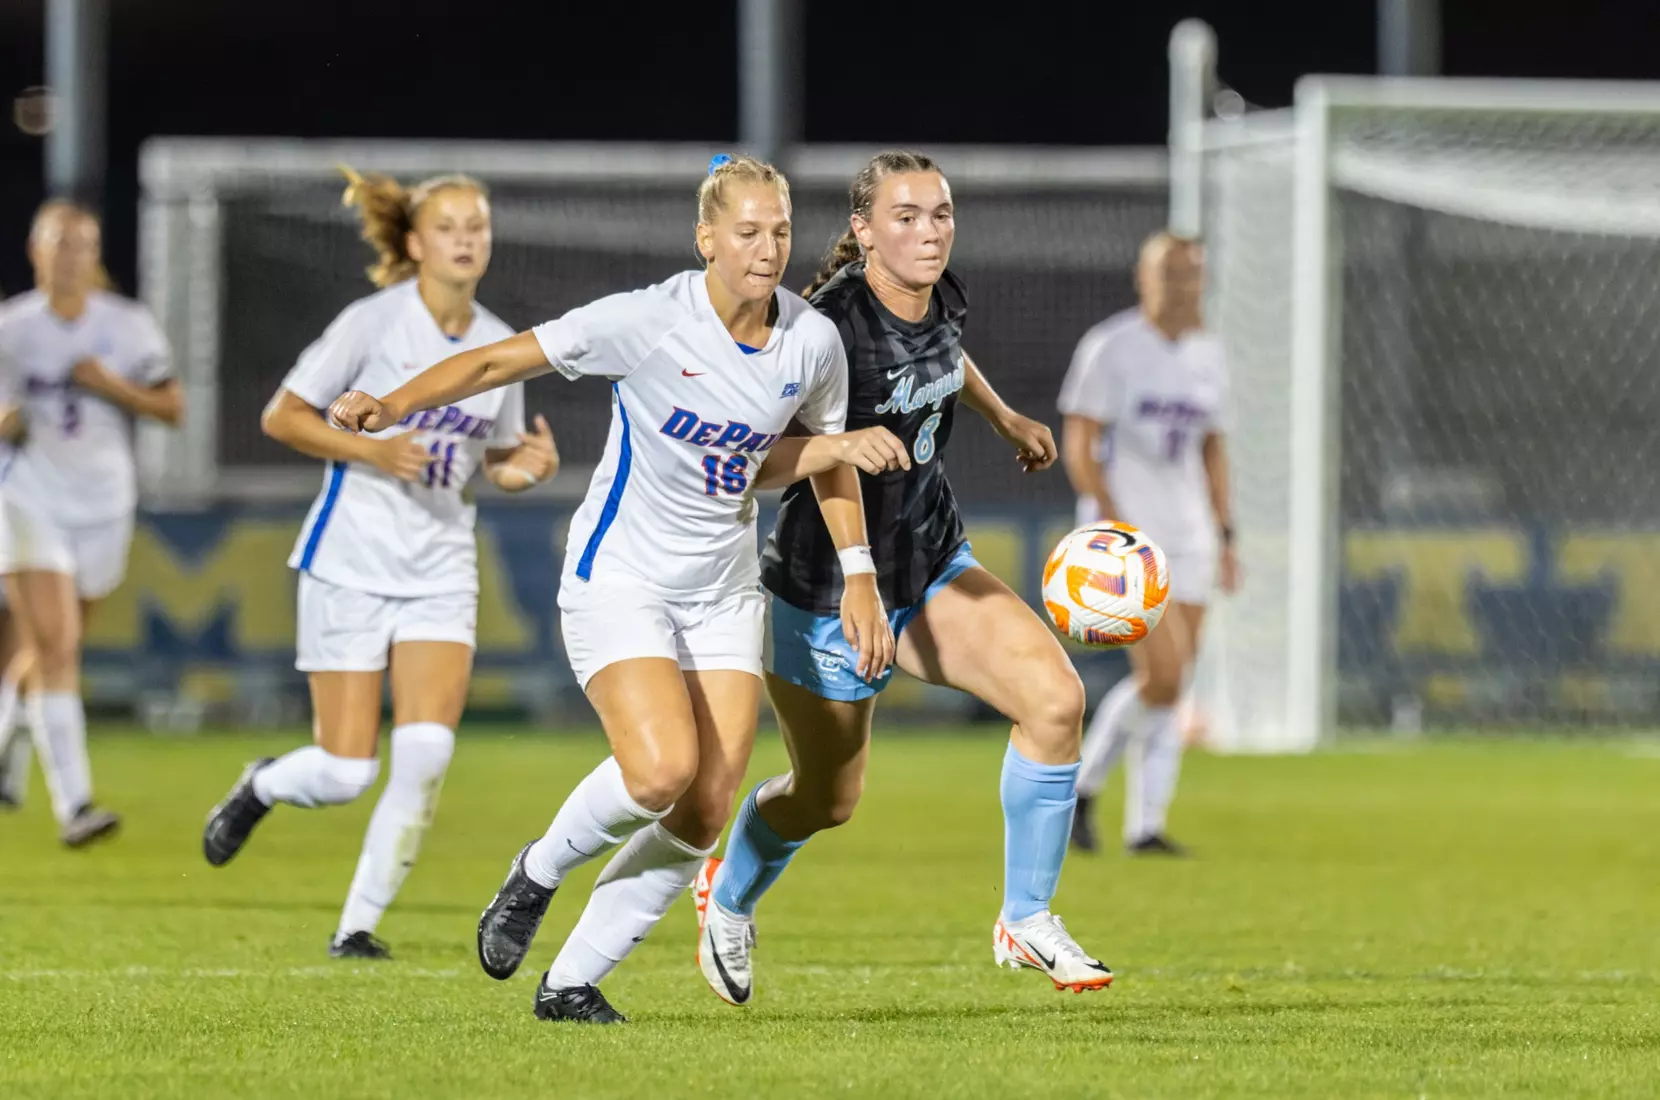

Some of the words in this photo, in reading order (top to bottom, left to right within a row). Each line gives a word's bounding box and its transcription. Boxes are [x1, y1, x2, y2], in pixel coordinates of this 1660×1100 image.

[913, 412, 943, 465] 8
[426, 440, 456, 488] 11
[701, 452, 749, 496] 16
